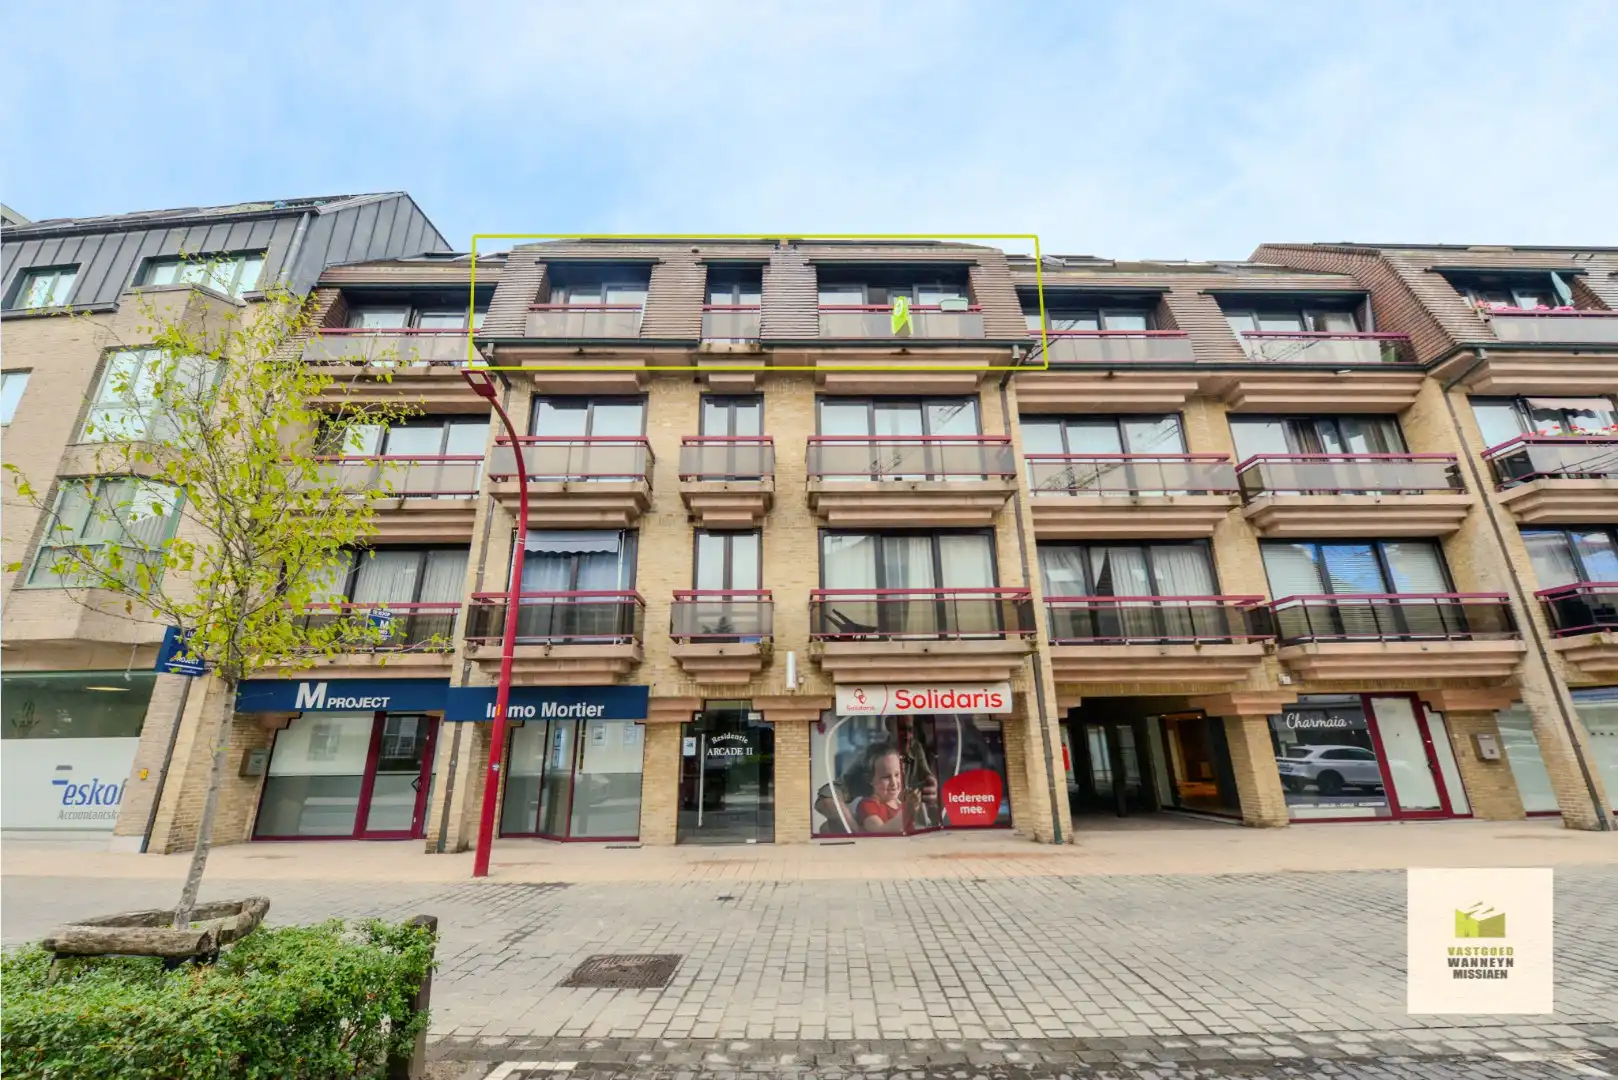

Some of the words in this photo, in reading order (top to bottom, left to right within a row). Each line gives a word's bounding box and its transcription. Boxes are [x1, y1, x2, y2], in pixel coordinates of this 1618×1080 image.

[295, 682, 328, 709] M
[326, 697, 391, 709] PROJECT
[895, 688, 1003, 710] Solidaris
[541, 702, 605, 717] Mortier
[1286, 712, 1348, 729] Charmaia
[711, 732, 749, 744] Residentie
[707, 747, 744, 756] ARCADE
[746, 747, 754, 756] II
[948, 791, 995, 803] iedereen
[960, 806, 986, 815] mee.
